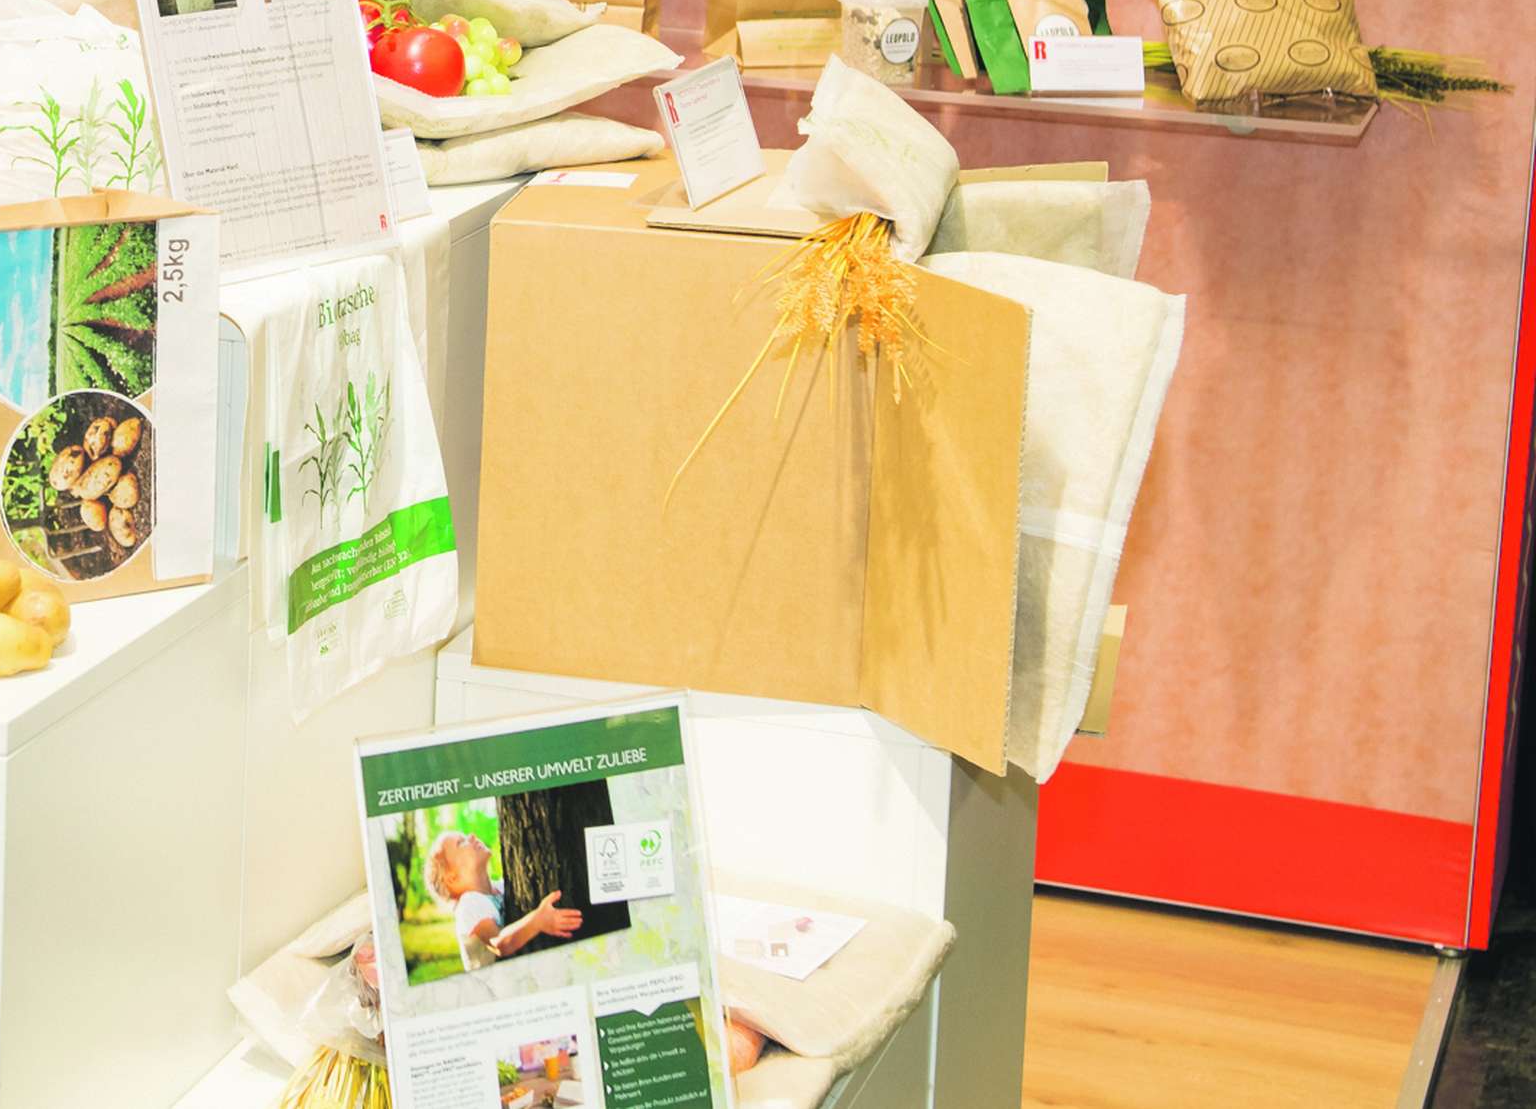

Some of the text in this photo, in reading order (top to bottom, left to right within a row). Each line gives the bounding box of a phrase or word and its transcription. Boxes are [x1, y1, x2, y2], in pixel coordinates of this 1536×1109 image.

[1034, 41, 1047, 60] R
[163, 238, 190, 304] 2,5kg
[378, 778, 461, 807] ZERTIFIZIERT
[474, 766, 535, 791] UNSERER
[537, 755, 594, 780] UMWELT
[596, 747, 648, 771] ZULIEBE
